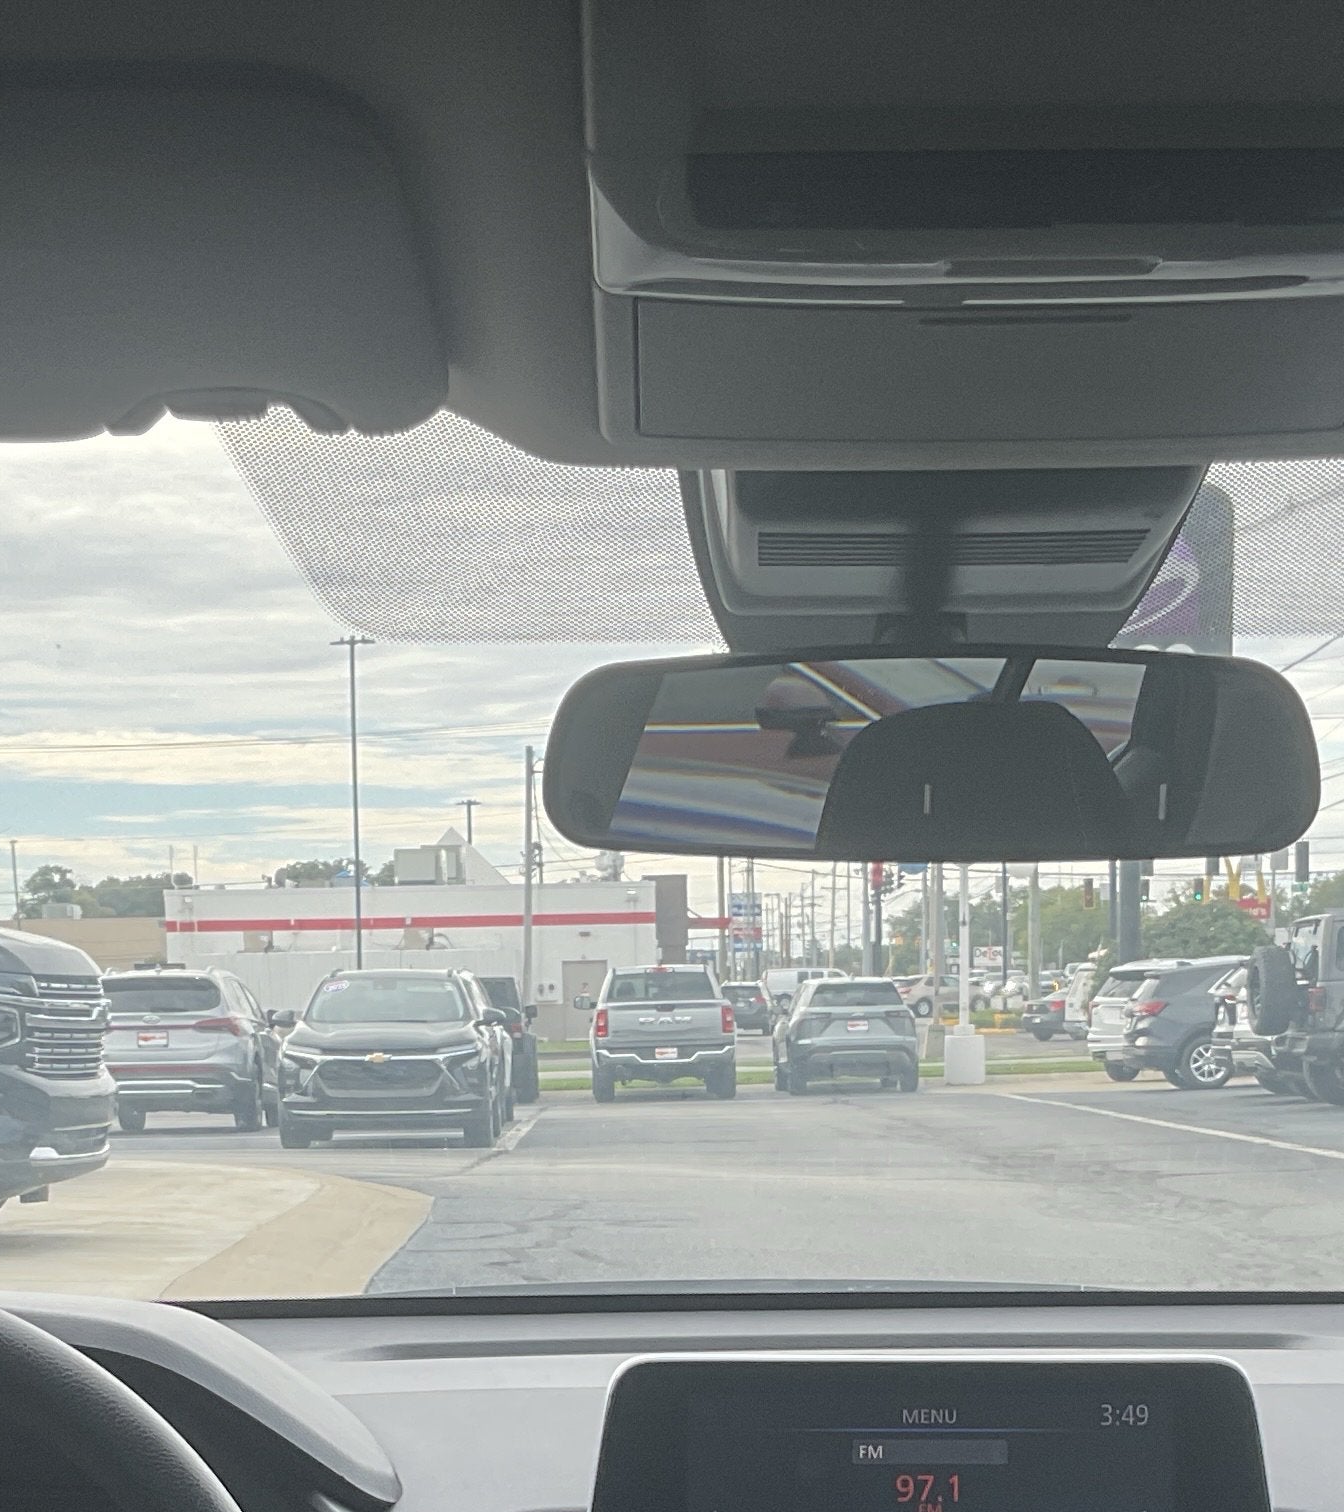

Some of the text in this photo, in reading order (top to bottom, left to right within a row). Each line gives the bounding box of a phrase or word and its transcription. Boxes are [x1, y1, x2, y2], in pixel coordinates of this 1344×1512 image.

[902, 1409, 957, 1424] MENU
[1100, 1404, 1149, 1426] 3:49
[859, 1445, 883, 1459] FM
[896, 1474, 960, 1502] 97.1
